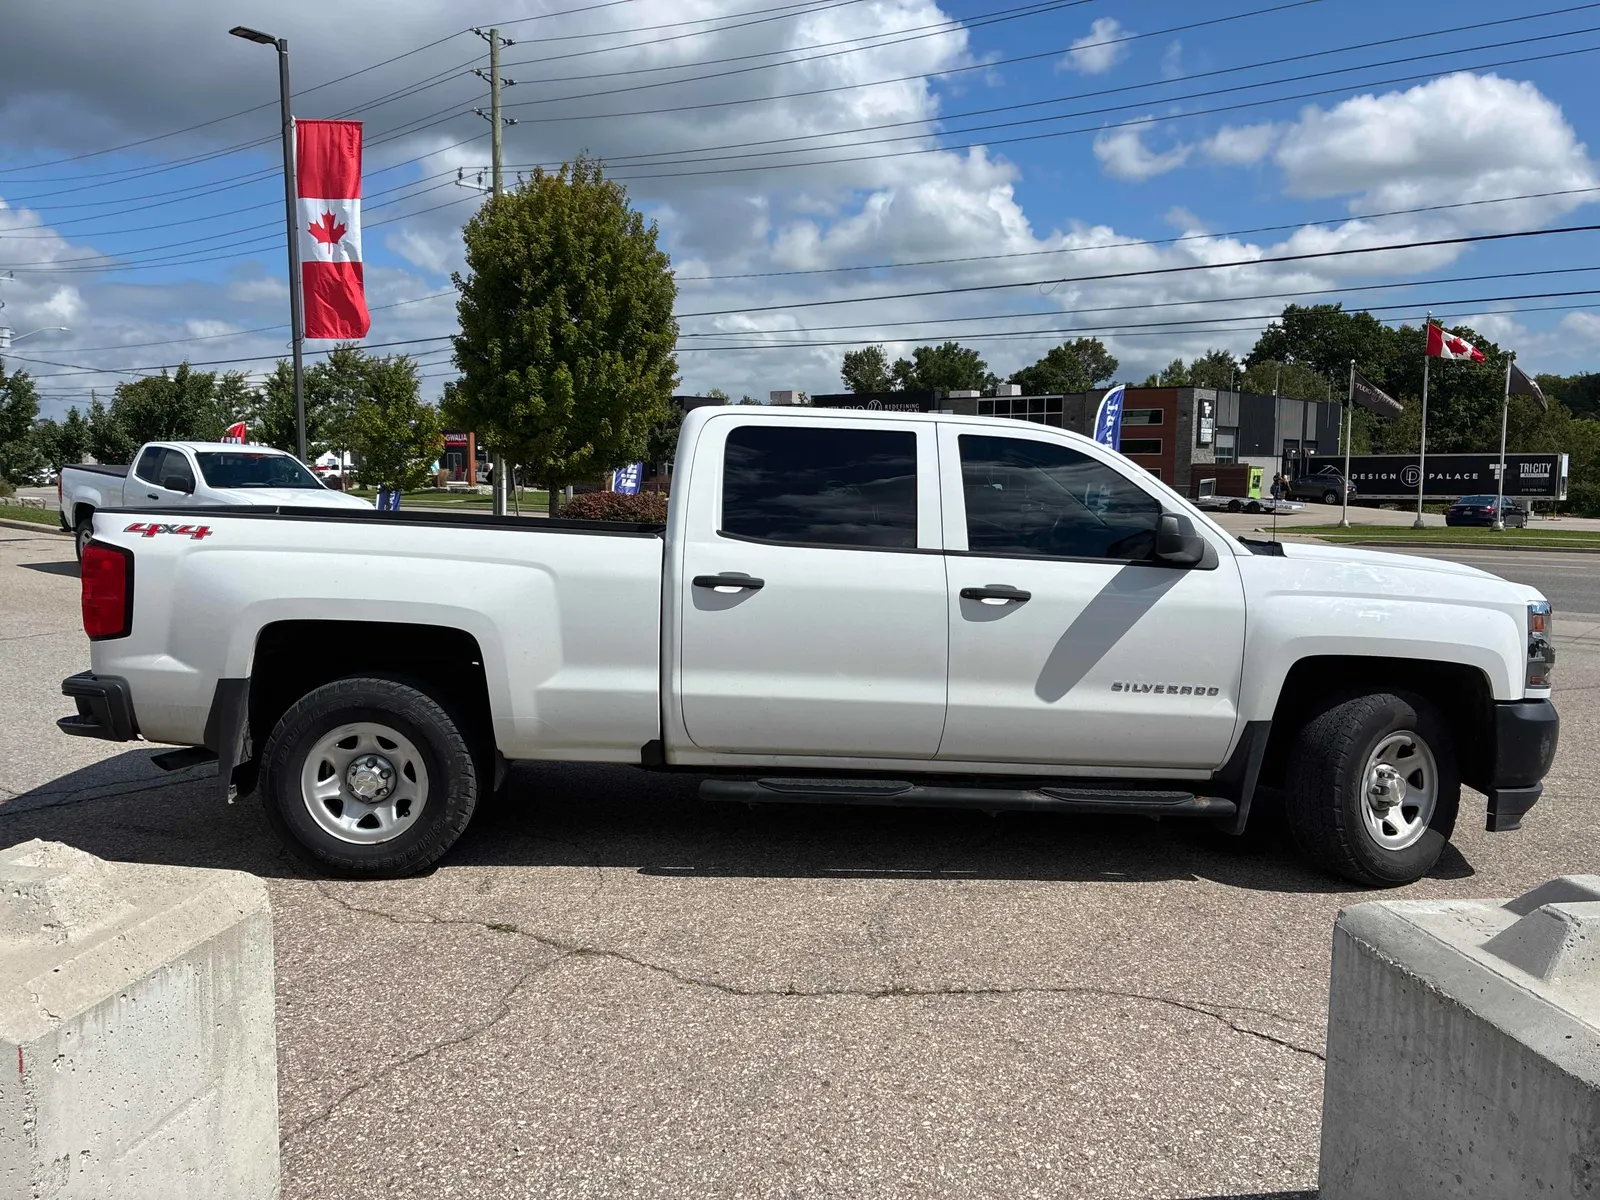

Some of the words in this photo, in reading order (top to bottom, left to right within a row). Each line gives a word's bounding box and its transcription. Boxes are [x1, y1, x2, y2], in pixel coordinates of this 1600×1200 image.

[1351, 472, 1397, 480] DESIGN
[1428, 472, 1479, 480] PALACE
[1110, 682, 1219, 697] SILVERADO
